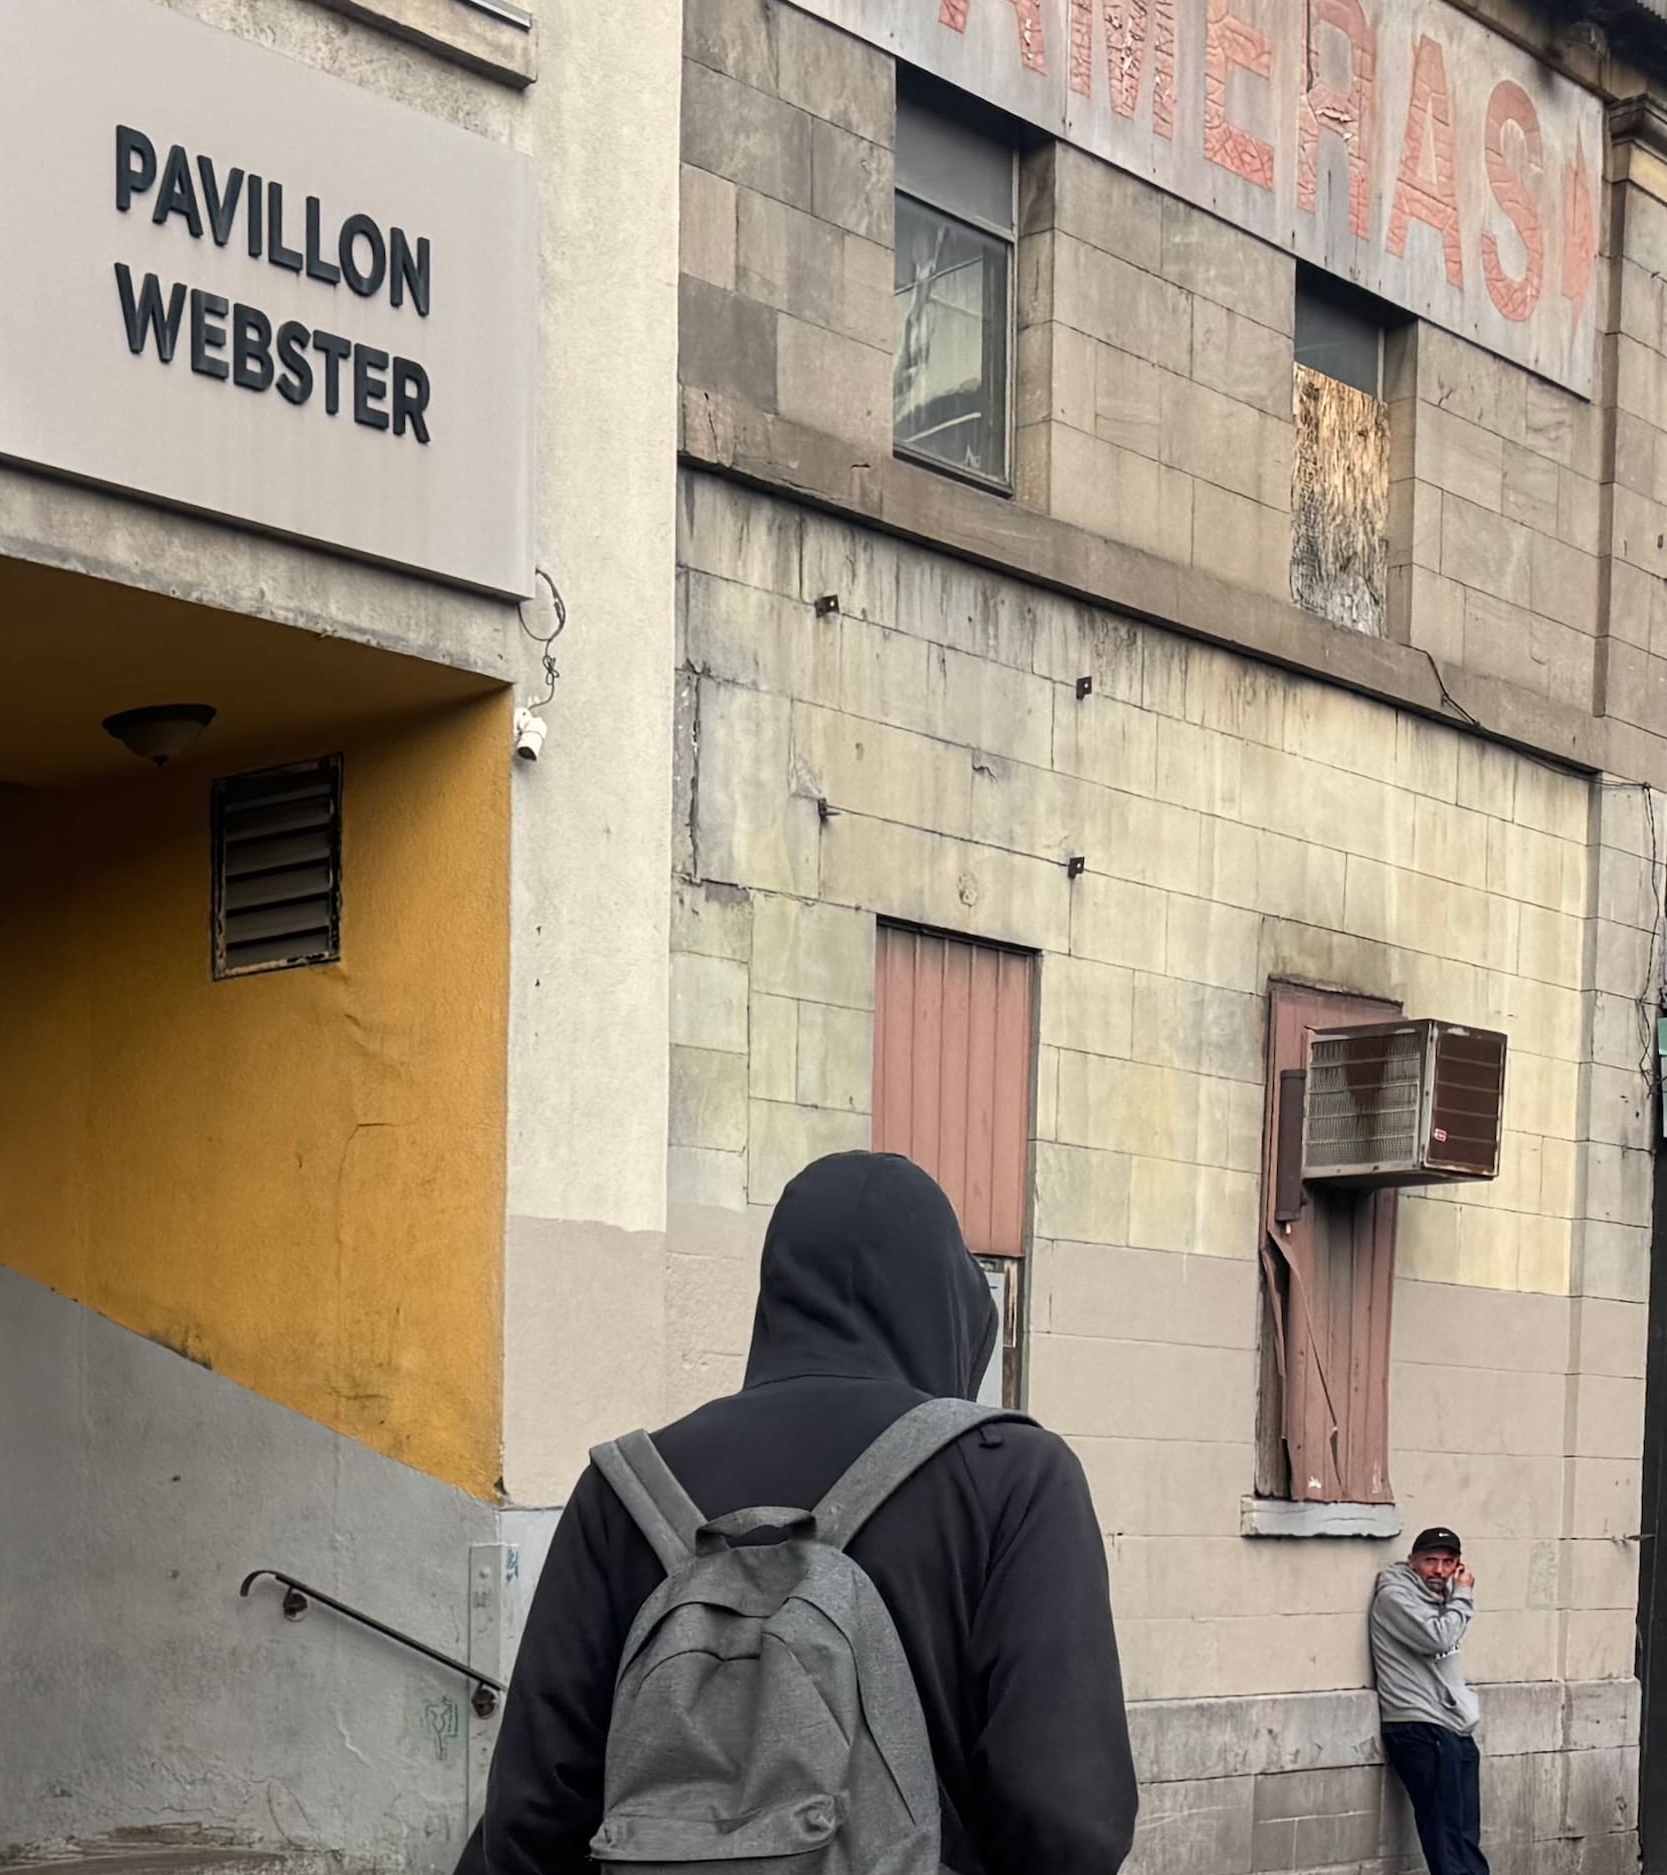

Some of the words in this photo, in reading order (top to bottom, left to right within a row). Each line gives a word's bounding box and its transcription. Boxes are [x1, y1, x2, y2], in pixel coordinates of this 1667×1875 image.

[115, 124, 431, 318] PAVILLON
[938, 0, 1543, 323] MERAS
[114, 262, 431, 445] WEBSTER
